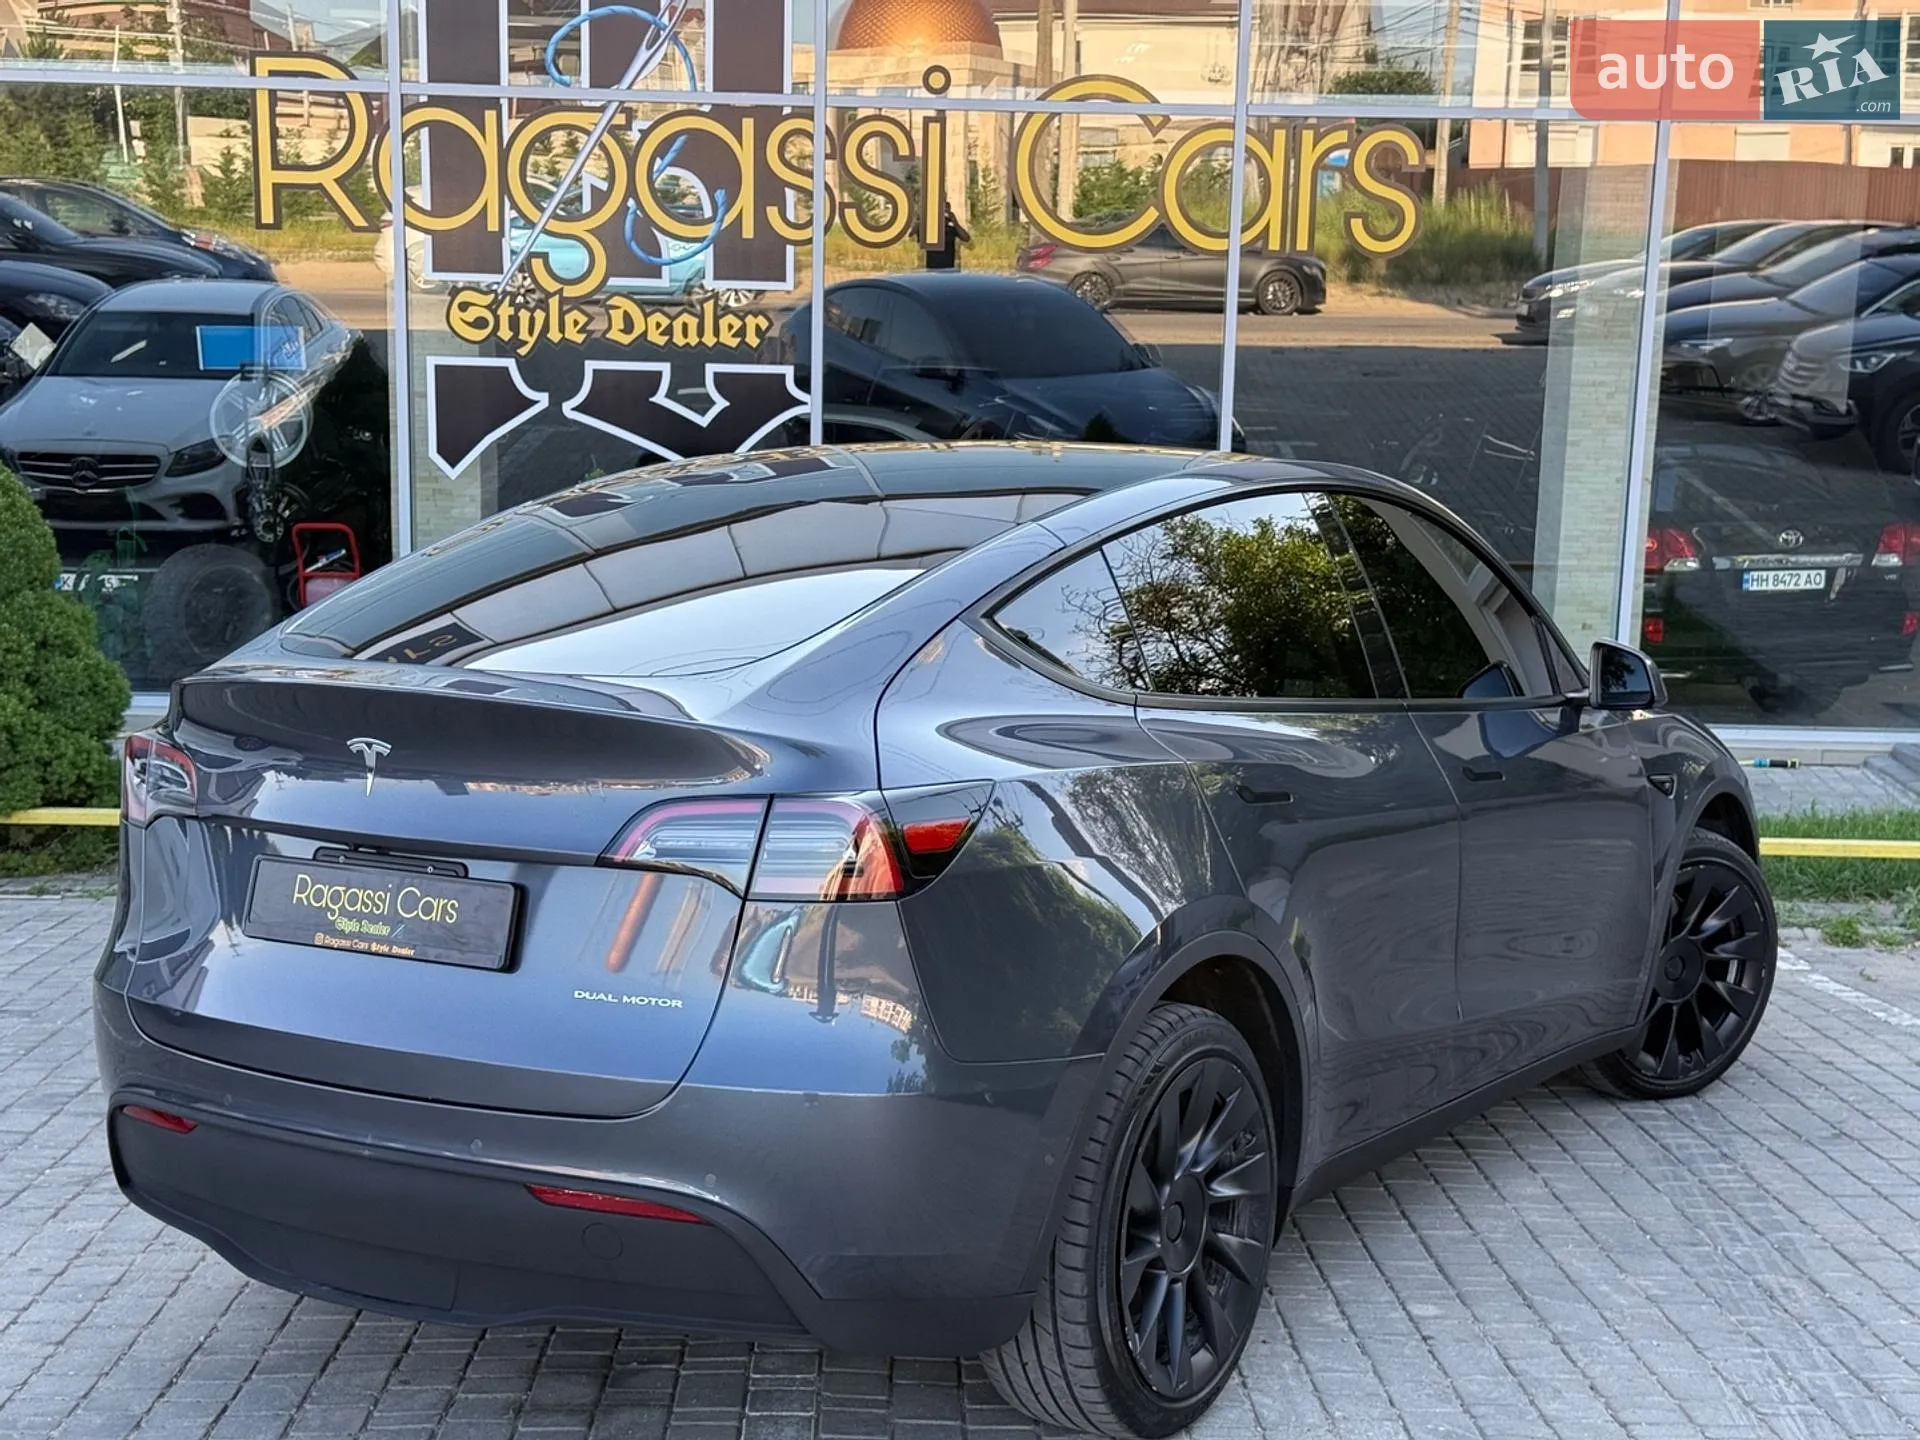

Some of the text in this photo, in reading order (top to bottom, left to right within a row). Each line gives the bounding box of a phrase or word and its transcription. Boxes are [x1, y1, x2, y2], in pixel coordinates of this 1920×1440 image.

[252, 54, 1422, 297] Ragassi Cars
[448, 287, 770, 357] Style Dealer
[1750, 572, 1823, 588] HH 8472 AO
[292, 874, 459, 924] Ragassi Cars
[574, 990, 684, 1009] DUAL MOTOR
